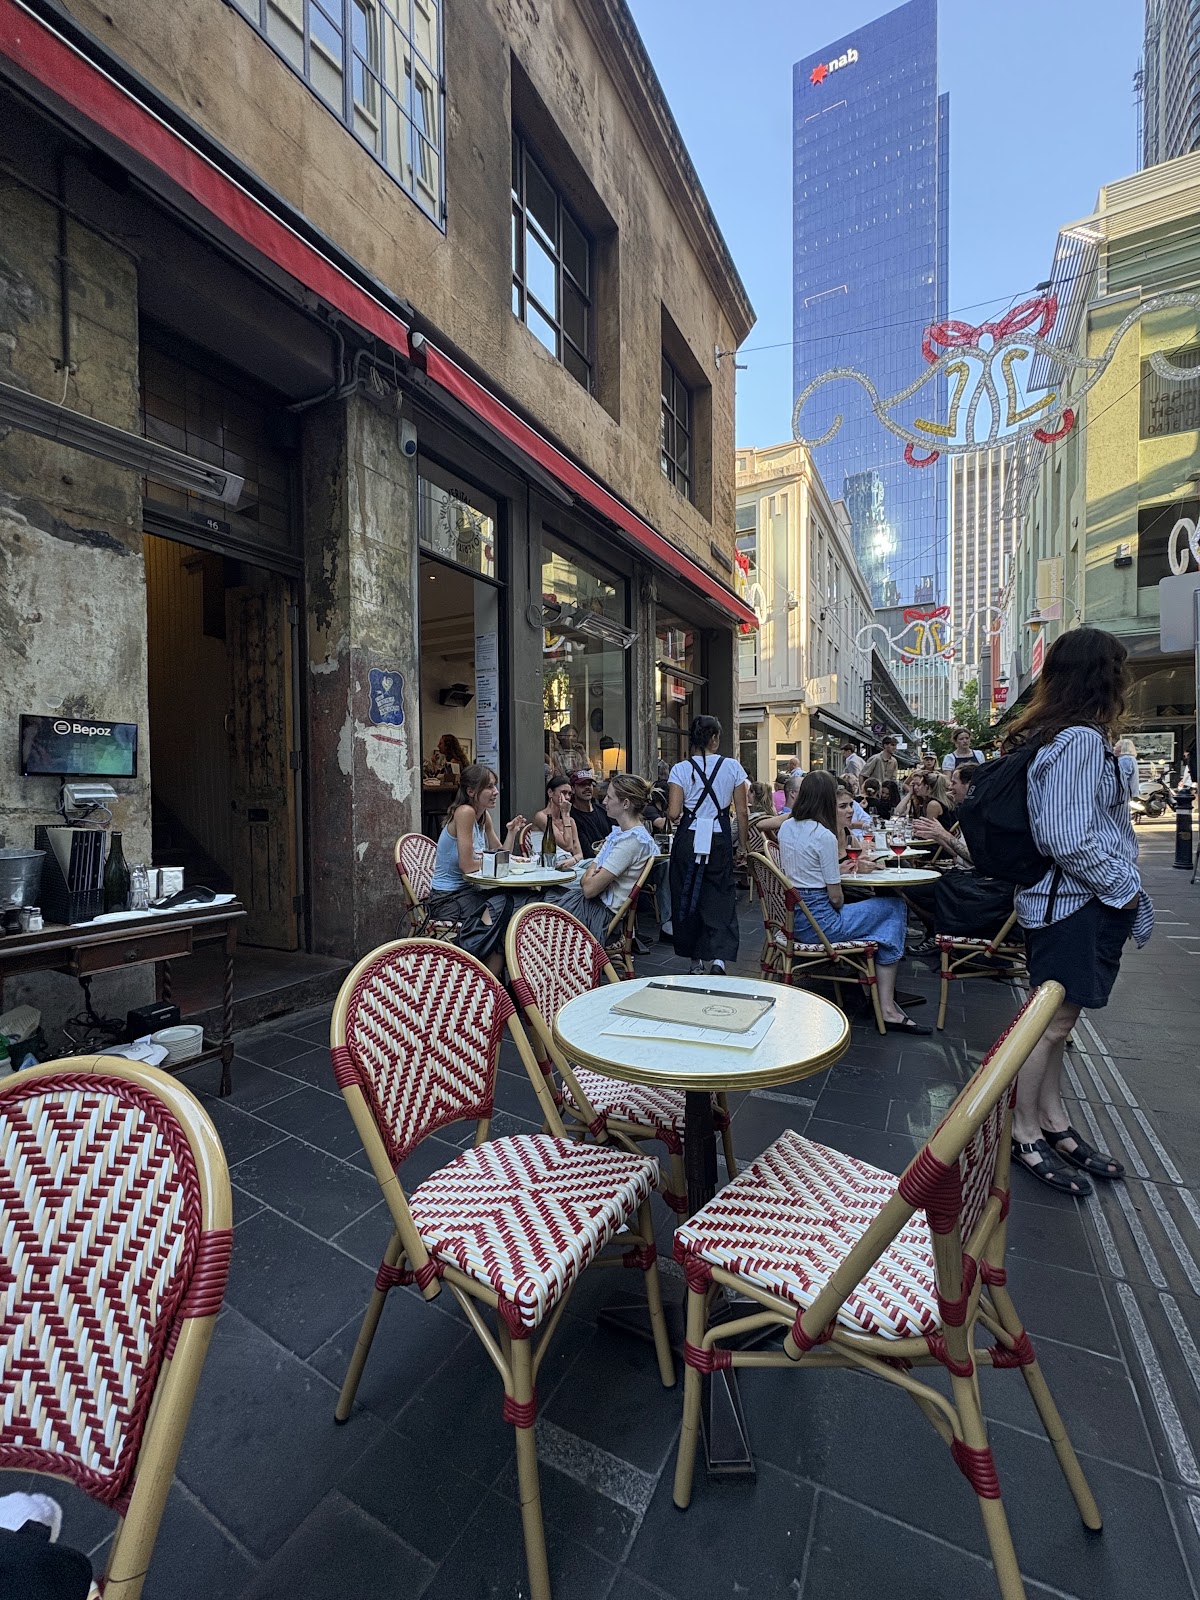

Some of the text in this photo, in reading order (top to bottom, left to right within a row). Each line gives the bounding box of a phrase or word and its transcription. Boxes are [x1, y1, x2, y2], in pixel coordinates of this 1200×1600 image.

[829, 48, 858, 72] nab
[1148, 420, 1181, 435] 0416
[207, 519, 219, 530] 46
[865, 685, 873, 725] BARBERS
[72, 723, 111, 737] Bepoz
